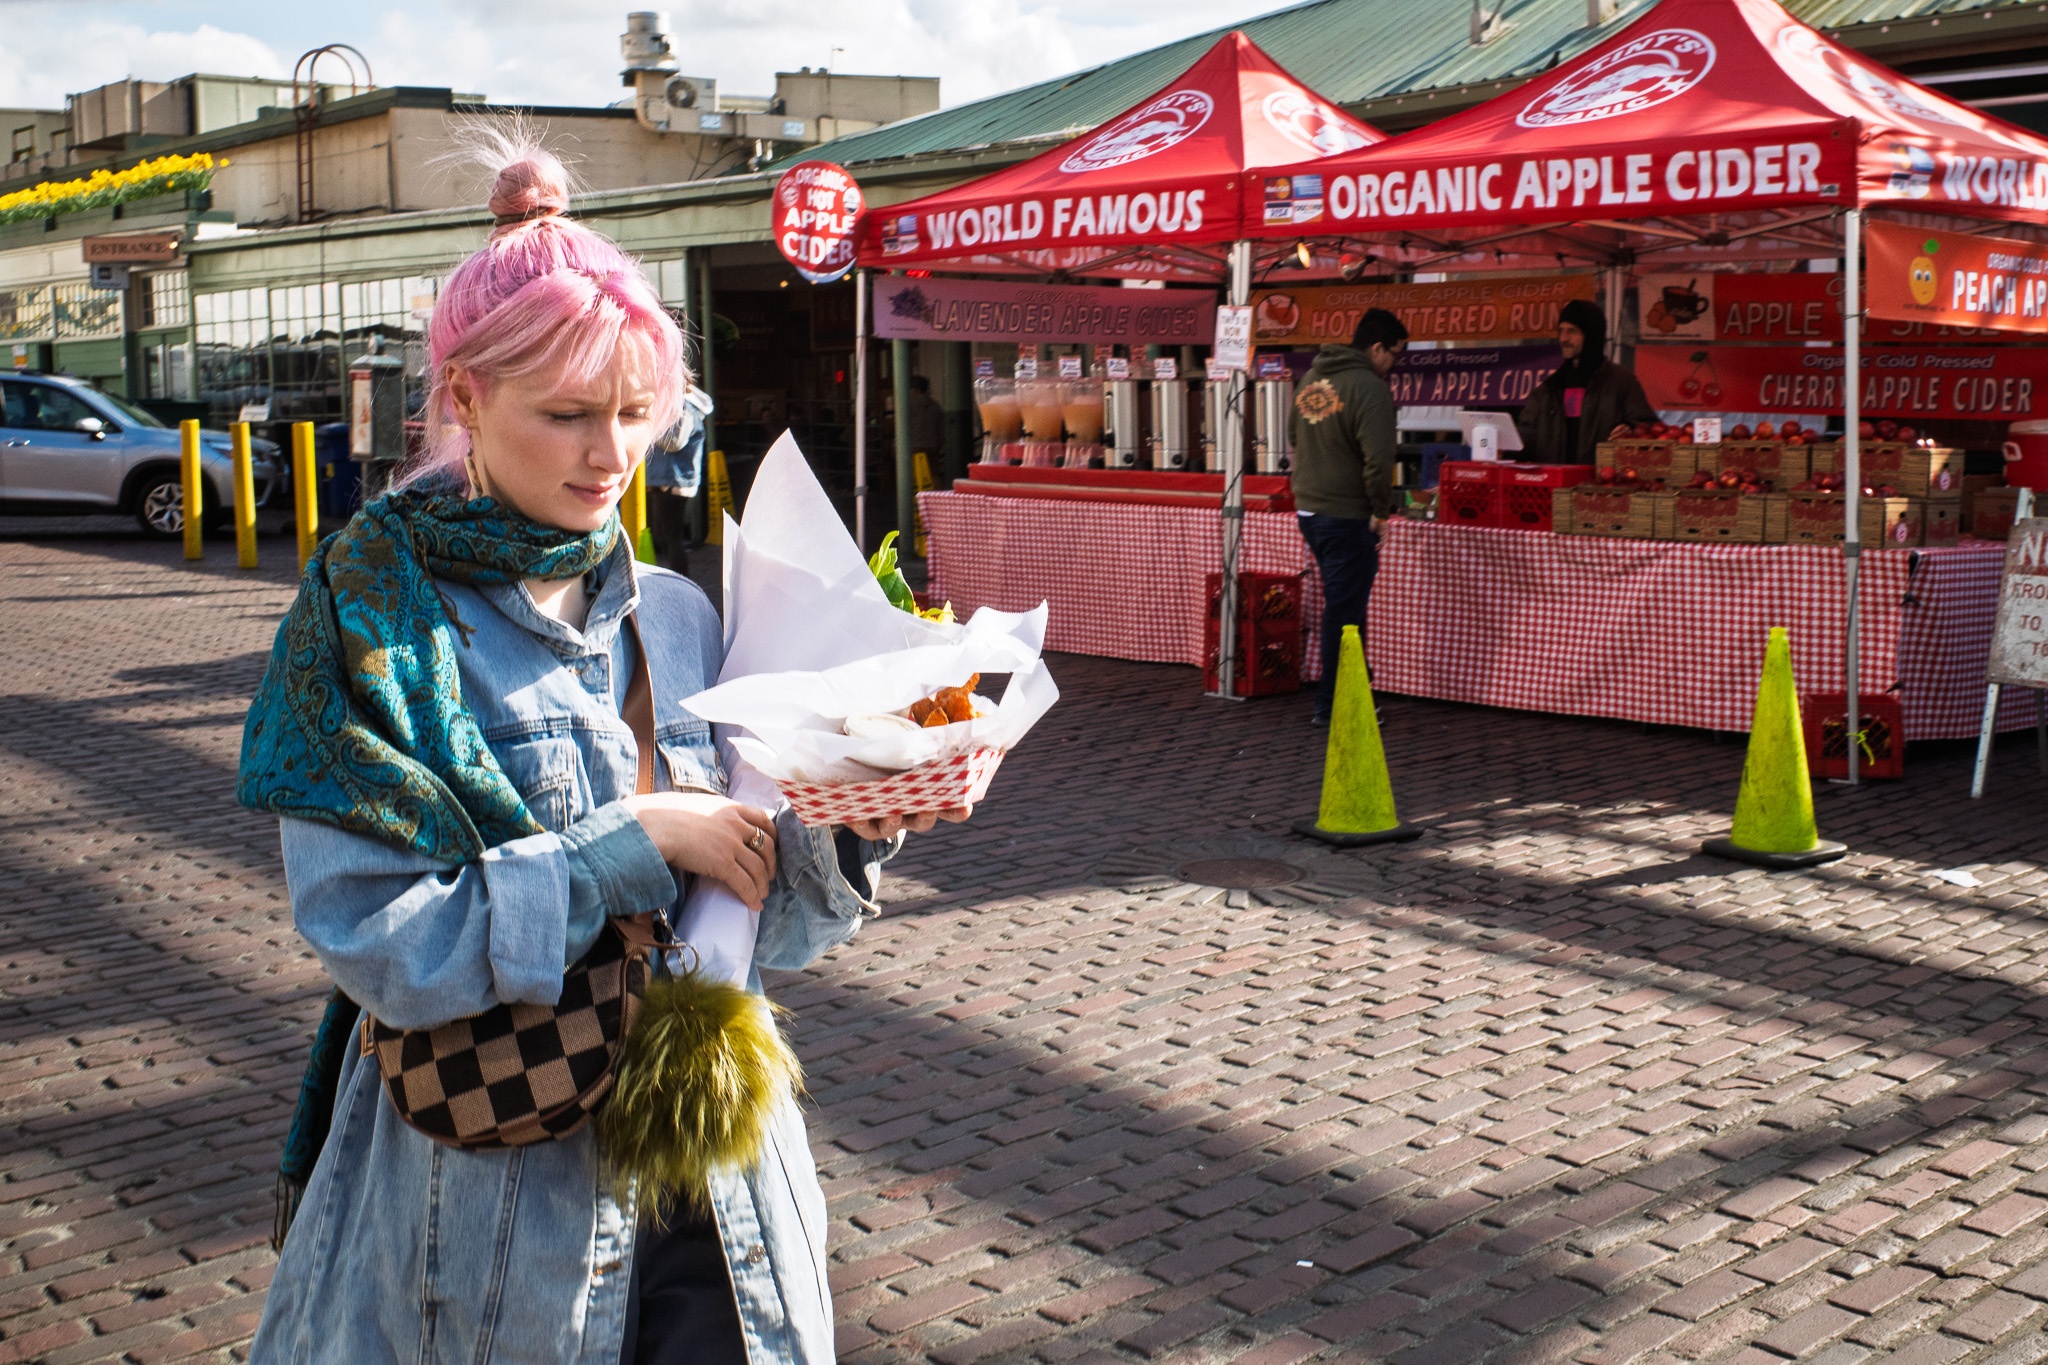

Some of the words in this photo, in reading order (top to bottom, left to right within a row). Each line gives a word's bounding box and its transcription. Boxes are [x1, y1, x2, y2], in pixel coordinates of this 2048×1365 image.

[795, 167, 849, 191] ORGANIC
[1328, 163, 1503, 221] ORGANIC
[1510, 152, 1654, 210] APPLE
[1664, 142, 1823, 202] CIDER
[1938, 153, 2048, 211] WORLD
[806, 187, 837, 211] HOT
[783, 207, 856, 235] APPLE
[926, 200, 1045, 250] WORLD
[1051, 189, 1206, 239] FAMOUS
[782, 231, 854, 265] CIDER
[1326, 289, 1422, 306] ORGANIC
[1427, 285, 1493, 302] APPLE
[1501, 281, 1569, 298] CIDER
[1952, 269, 2018, 315] PEACH
[2022, 279, 2048, 318] AP
[931, 298, 1052, 334] LAVENDER
[1058, 304, 1130, 336] APPLE
[1135, 305, 1199, 338] CIDER
[1311, 309, 1361, 340] HOT
[1390, 304, 1498, 335] TTERED
[1722, 301, 1825, 336] APPLE
[1410, 352, 1441, 366] Cold
[1446, 351, 1500, 365] Pressed
[1802, 354, 1870, 370] Orgac
[1875, 354, 1918, 369] Cold
[1923, 354, 1996, 370] Pressed
[1431, 370, 1492, 401] APPLE
[1499, 368, 1557, 401] CIDE
[1862, 375, 1942, 411] APPLE
[1952, 377, 2034, 413] CIDER
[2013, 583, 2048, 600] FRO
[2021, 615, 2042, 631] TO
